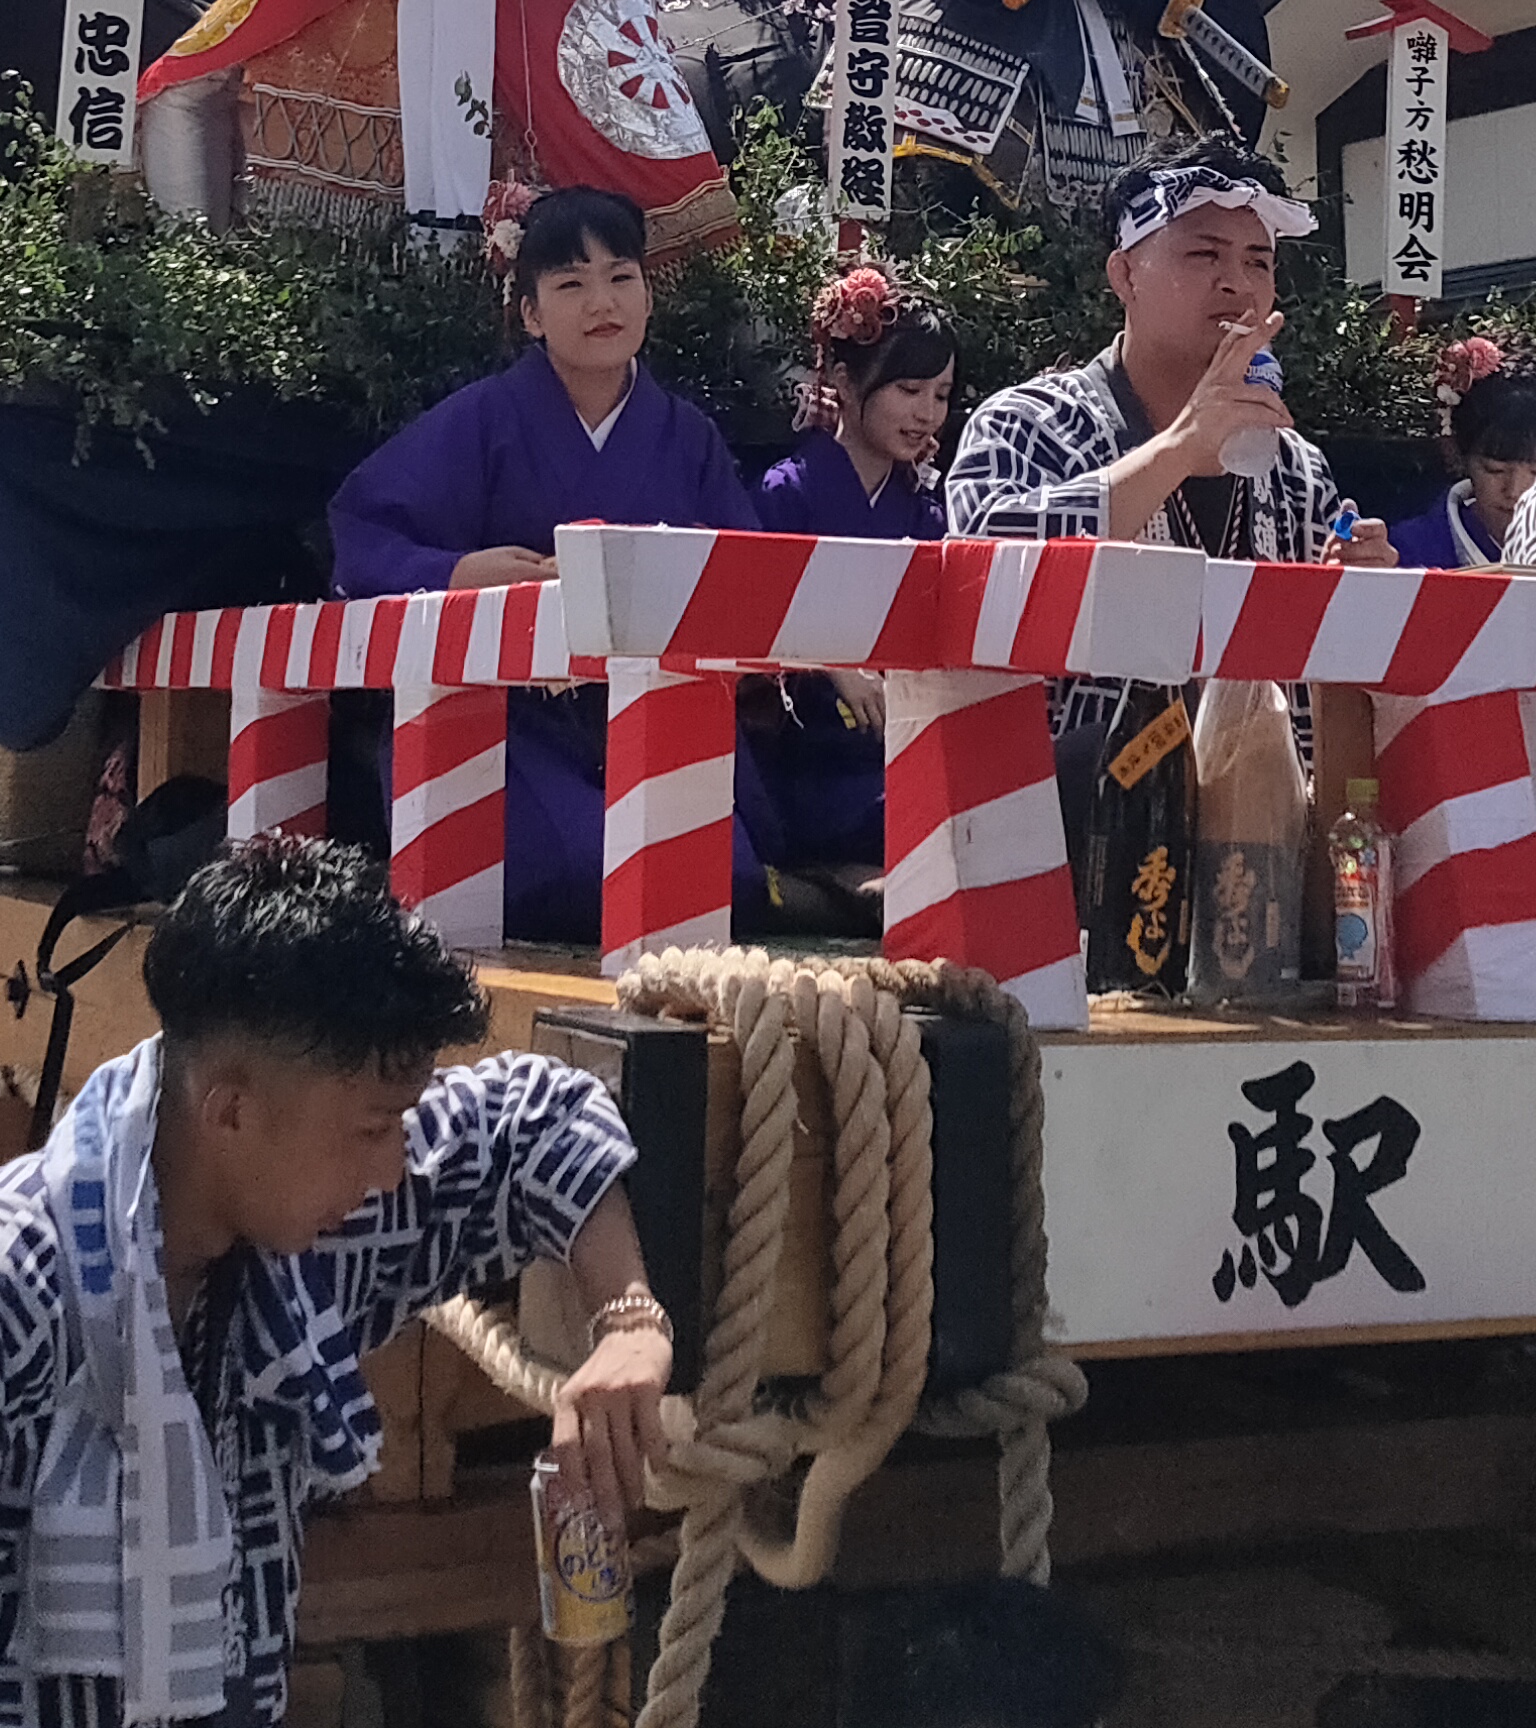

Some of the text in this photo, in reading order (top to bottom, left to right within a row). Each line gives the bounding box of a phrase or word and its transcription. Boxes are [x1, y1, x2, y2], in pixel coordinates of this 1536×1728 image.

[1391, 30, 1440, 283] 囃子方愁明会
